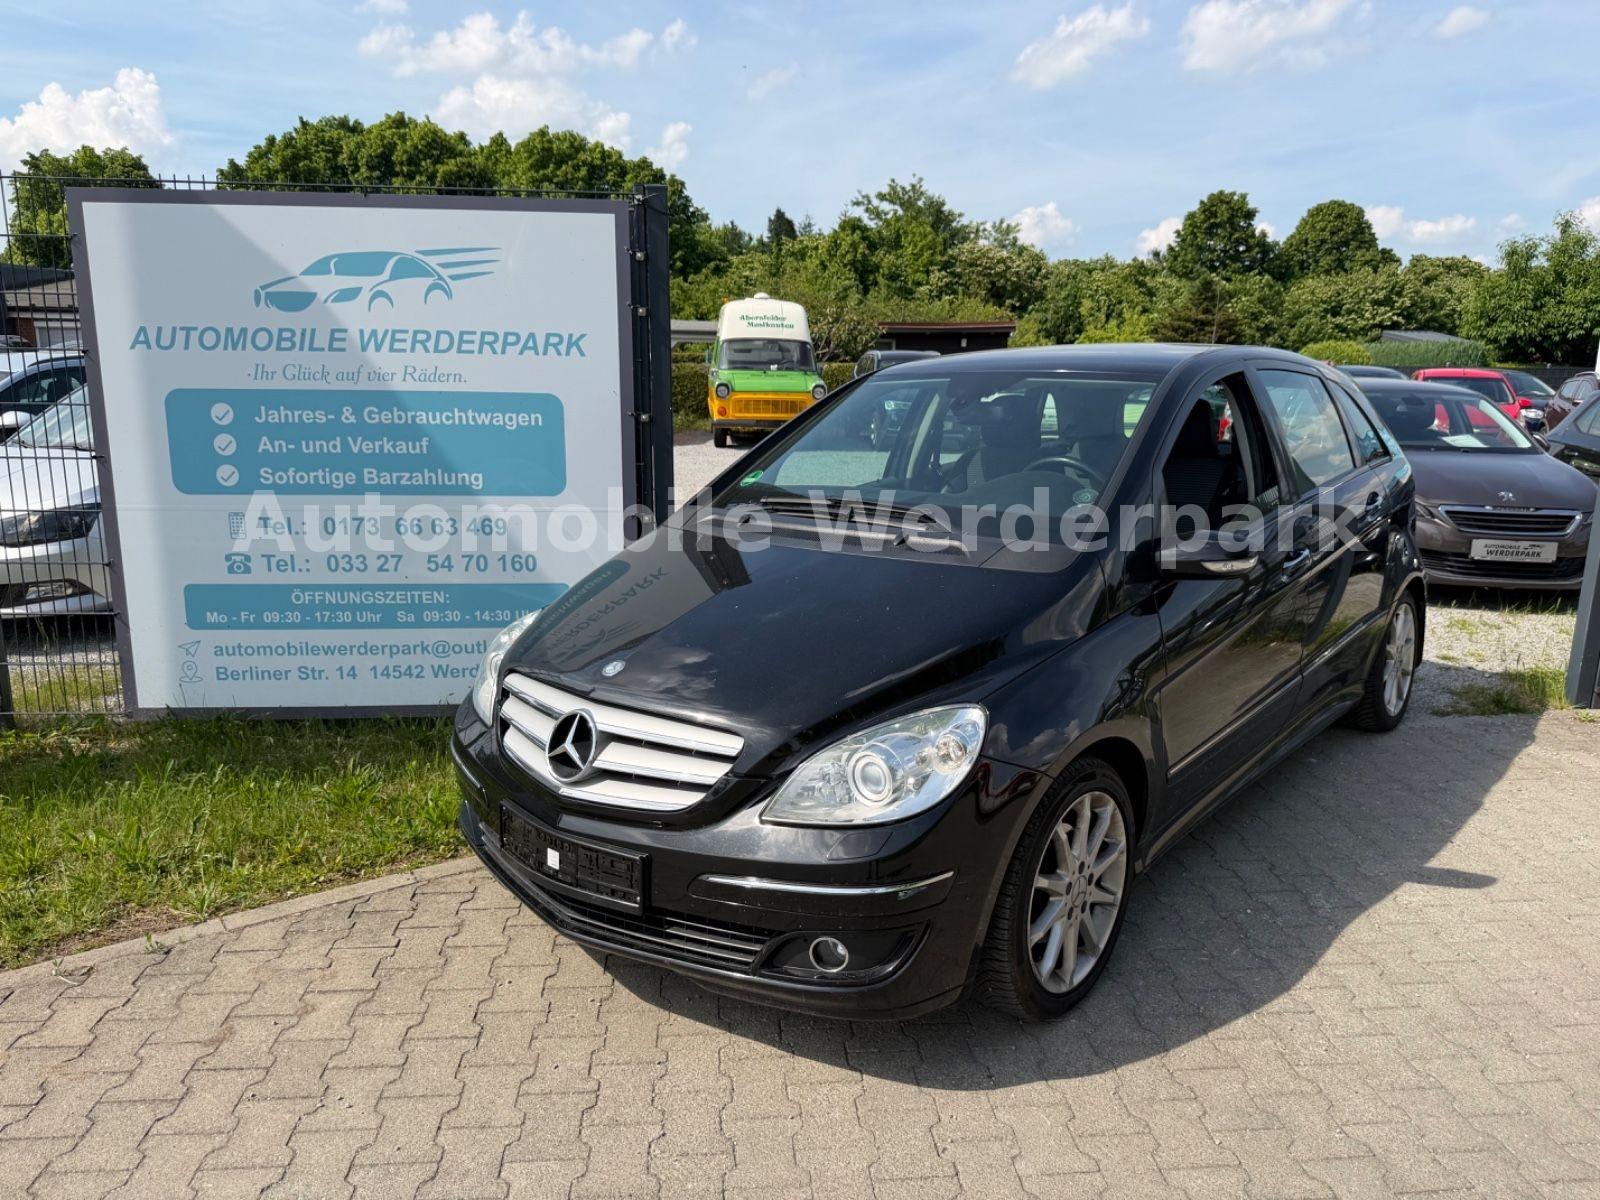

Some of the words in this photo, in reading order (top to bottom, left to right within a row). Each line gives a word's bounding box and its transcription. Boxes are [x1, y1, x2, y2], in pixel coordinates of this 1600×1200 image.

[129, 325, 349, 353] AUTOMOBILE
[358, 327, 588, 358] WERDERPARK
[282, 363, 331, 385] Glück
[335, 365, 365, 385] auf
[367, 367, 397, 383] vier
[402, 364, 468, 384] Rädern.
[254, 406, 335, 424] Jahres-
[340, 406, 357, 424] &
[363, 406, 543, 430] Gebrauchtwagen
[257, 436, 295, 454] An-
[301, 436, 342, 454] und
[347, 436, 430, 455] Verkauf
[259, 467, 357, 489] Sofortige
[363, 467, 484, 490] Barzahlung
[258, 516, 307, 536] Tel.:
[323, 516, 380, 536] 0173
[394, 517, 423, 536] 66
[430, 517, 458, 536] 63
[466, 517, 508, 536] 469
[1486, 549, 1543, 558] WERDERPARK
[260, 554, 311, 573] Tel.:
[326, 554, 368, 573] 033
[375, 554, 404, 573] 27
[426, 554, 454, 573] 54
[461, 554, 489, 573] 70
[497, 554, 538, 573] 160
[291, 588, 451, 605] ÖFFNUNGSZEITEN:
[206, 611, 228, 623] Mo
[240, 611, 255, 623] Fr
[263, 611, 301, 623] 09:30
[314, 611, 352, 623] 17:30
[356, 611, 382, 623] Uhr
[396, 610, 415, 623] Sa
[423, 610, 461, 622] 09:30
[474, 609, 511, 622] 14:30
[215, 666, 292, 681] Berliner
[297, 665, 329, 681] Str.
[335, 665, 358, 680] 14
[369, 664, 425, 680] 14542
